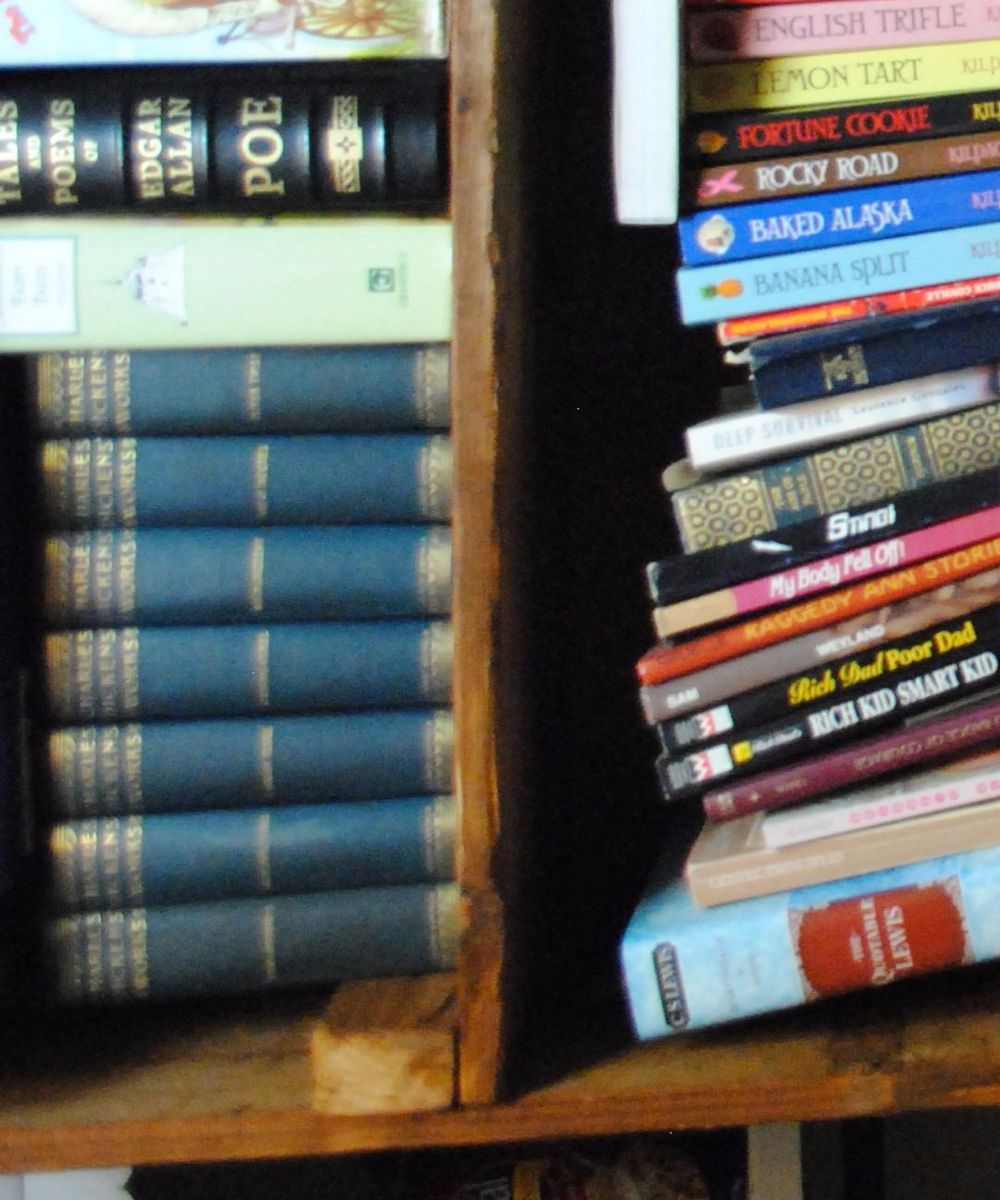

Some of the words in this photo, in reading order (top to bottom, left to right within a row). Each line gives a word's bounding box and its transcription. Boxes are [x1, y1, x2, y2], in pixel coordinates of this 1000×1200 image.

[754, 12, 866, 43] ENGLISH
[875, 3, 966, 33] TRIFLE
[752, 65, 849, 96] LEMON
[857, 59, 923, 86] TART
[49, 97, 78, 205] POEMS
[140, 97, 166, 200] EDGAR
[167, 96, 195, 199] ALLAN
[241, 94, 285, 198] POE
[738, 116, 841, 151] FORTUNE
[847, 105, 932, 138] COOKIE
[757, 160, 831, 192] ROCKY
[839, 152, 899, 179] ROAD
[750, 211, 825, 243] BAKED
[831, 199, 913, 233] ALASKA
[754, 266, 844, 295] BANANA
[851, 250, 912, 284] SPLIT
[713, 425, 756, 451] DEEP
[743, 591, 854, 639] RAGGEDY
[863, 571, 916, 599] ANN
[769, 575, 796, 599] My
[798, 560, 841, 589] Body
[843, 549, 872, 575] Fell
[667, 688, 700, 708] SAM
[816, 625, 885, 656] WEYLAND
[787, 674, 834, 705] Rich
[839, 650, 885, 686] Dad
[886, 643, 933, 672] Poor
[935, 623, 977, 651] Dad
[808, 704, 854, 738] RICH
[857, 689, 897, 722] KID
[899, 666, 961, 713] SMART
[963, 650, 999, 683] KID
[861, 897, 895, 986] QUOTABLE
[884, 905, 914, 970] LEWIS
